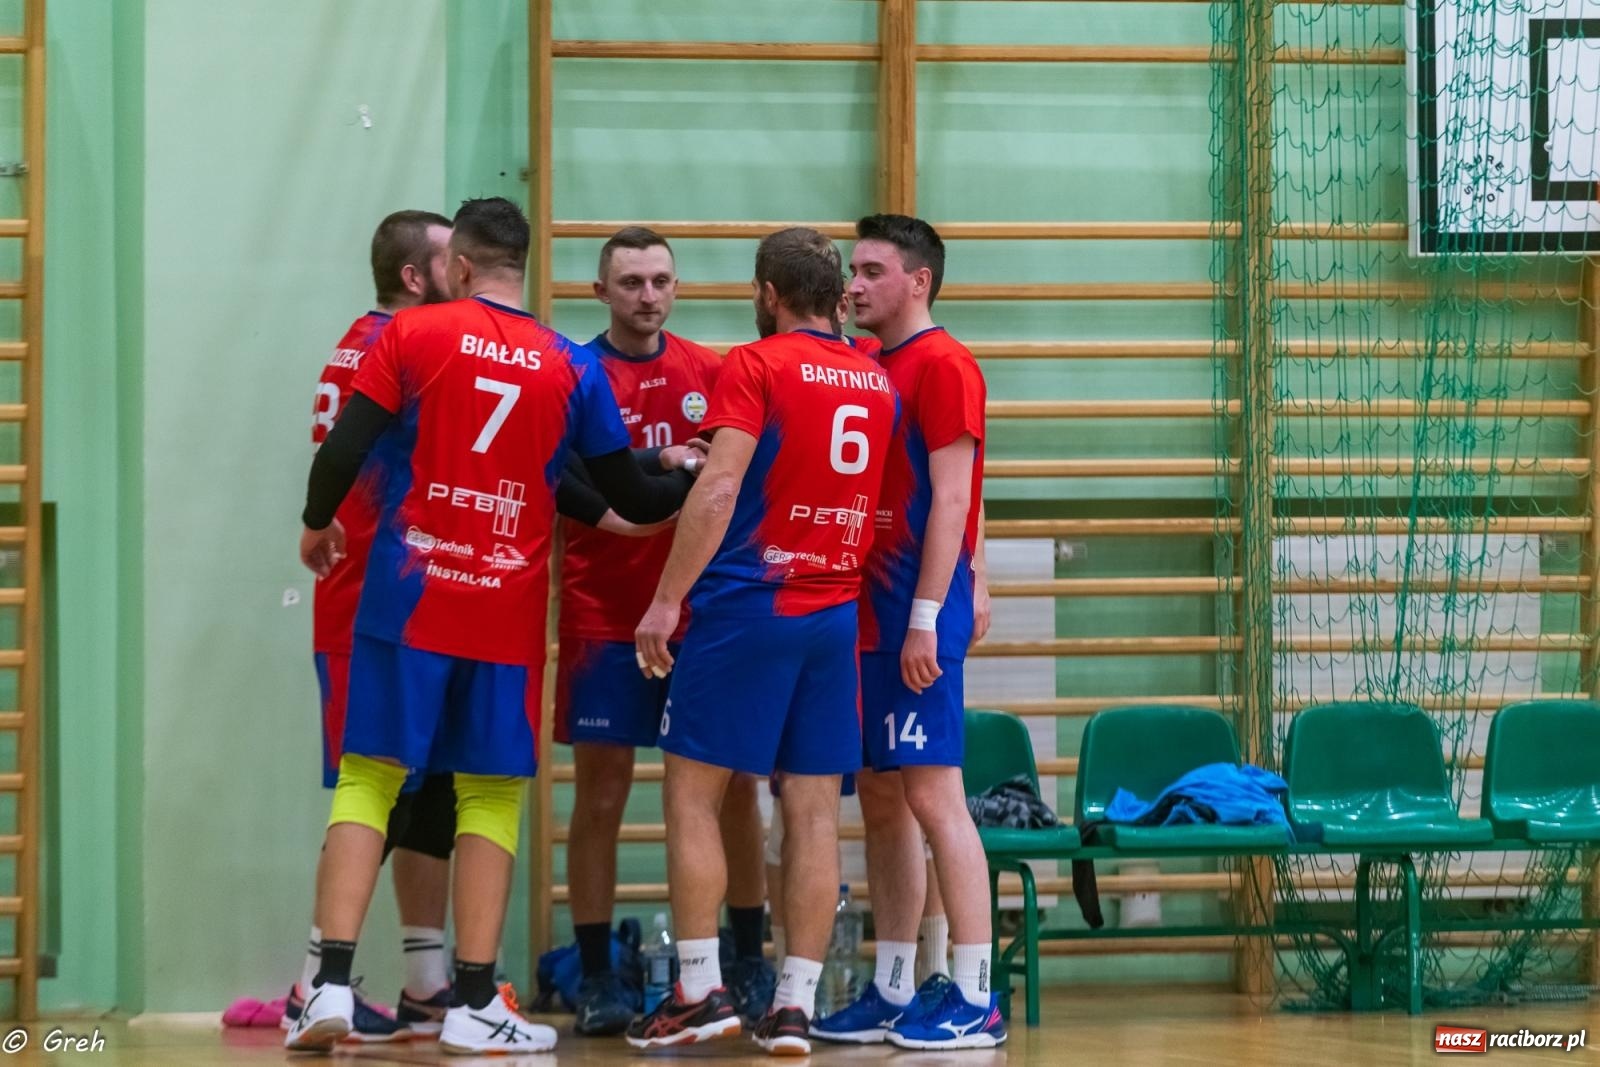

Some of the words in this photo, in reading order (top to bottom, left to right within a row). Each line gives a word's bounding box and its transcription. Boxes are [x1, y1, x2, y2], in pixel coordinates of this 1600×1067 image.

[460, 333, 542, 371] BIAŁAS
[800, 363, 890, 394] BARTNICKI
[471, 376, 522, 454] 7
[641, 421, 673, 449] 10
[830, 404, 870, 475] 6
[660, 698, 672, 736] 6
[884, 711, 928, 751] 14
